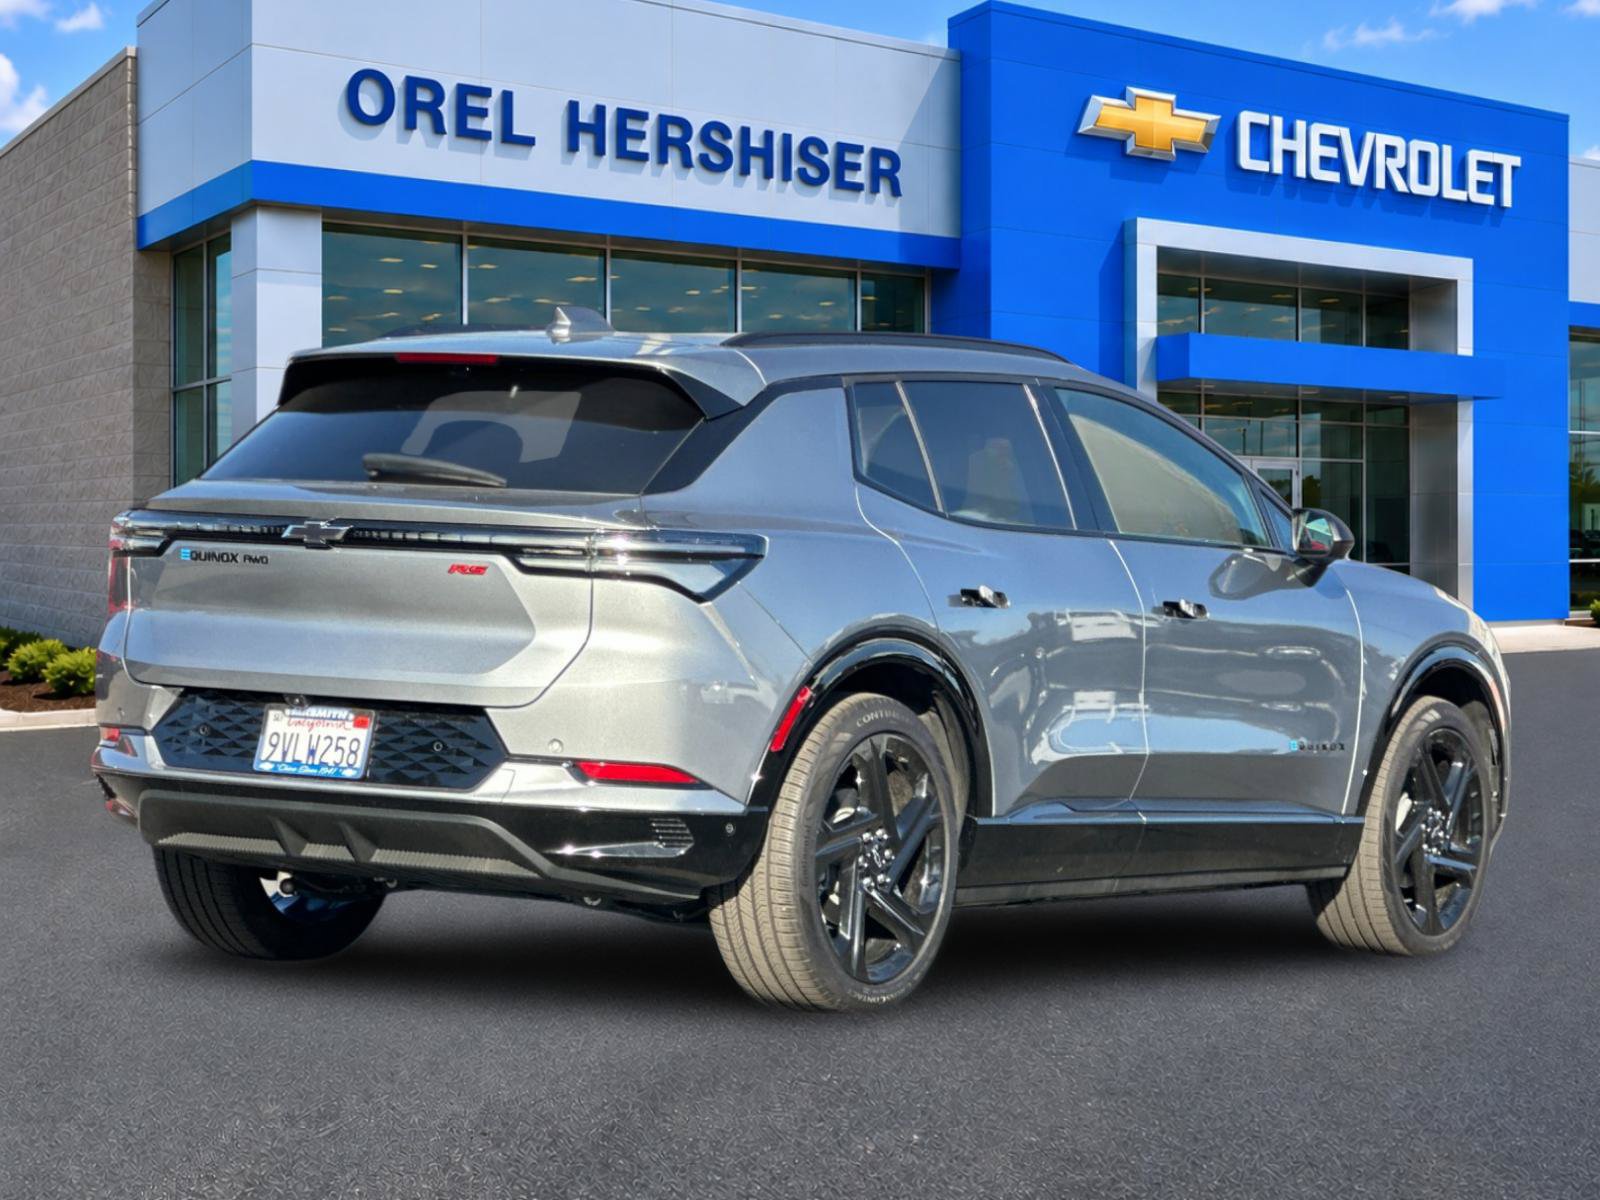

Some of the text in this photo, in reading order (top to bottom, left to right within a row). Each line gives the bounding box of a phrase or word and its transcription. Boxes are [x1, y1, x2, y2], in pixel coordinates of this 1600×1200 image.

[346, 68, 902, 197] OREL HERSHISER
[1237, 110, 1522, 208] CHEVROLET
[180, 547, 239, 564] EQUINOX
[448, 563, 489, 576] RS
[266, 731, 361, 767] 9VLW258
